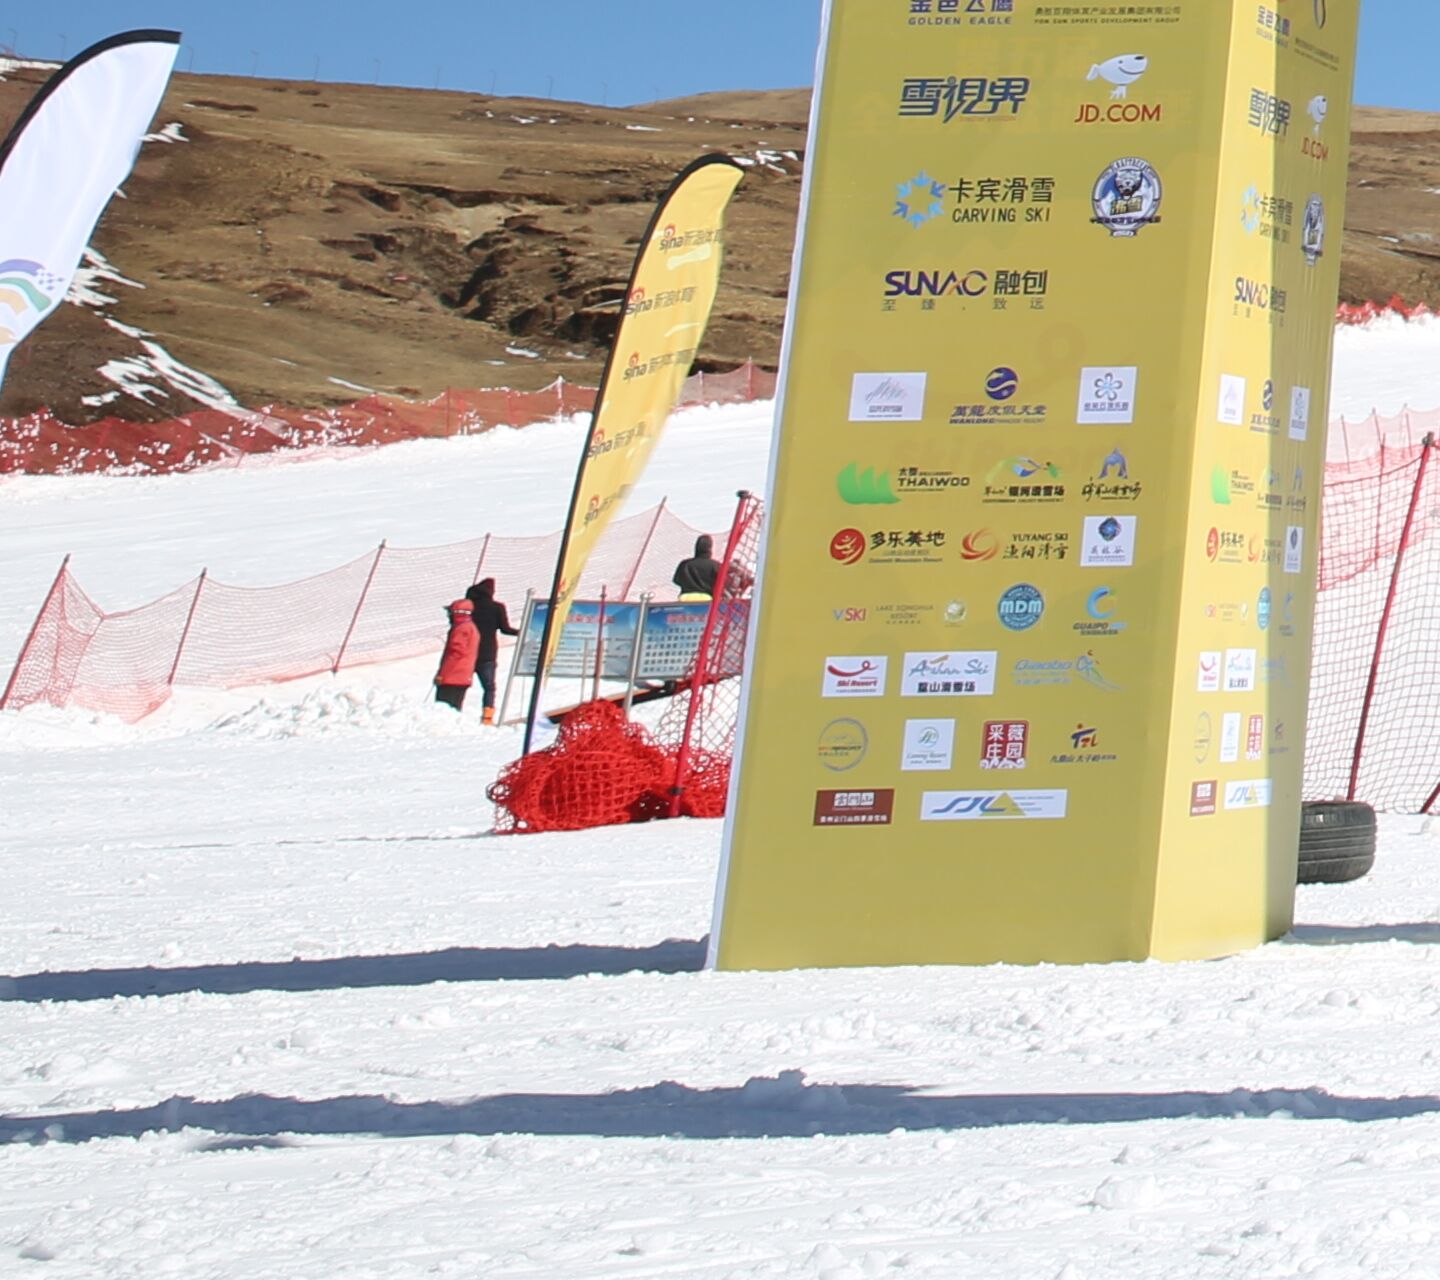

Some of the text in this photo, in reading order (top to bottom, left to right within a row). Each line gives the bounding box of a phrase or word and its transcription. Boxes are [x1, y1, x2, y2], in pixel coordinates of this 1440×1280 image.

[908, 16, 1012, 26] GOLDEN EAGLE
[1074, 104, 1162, 123] JD.COM
[948, 177, 1055, 203] 卡宾滑雪
[952, 207, 1050, 223] CARVING SKI
[884, 270, 1048, 296] SUNAC 融创
[898, 476, 970, 487] THAIWOO
[869, 530, 946, 551] 多乐美地
[1012, 532, 1069, 542] YUYANG SKI
[1000, 599, 1042, 614] MDM
